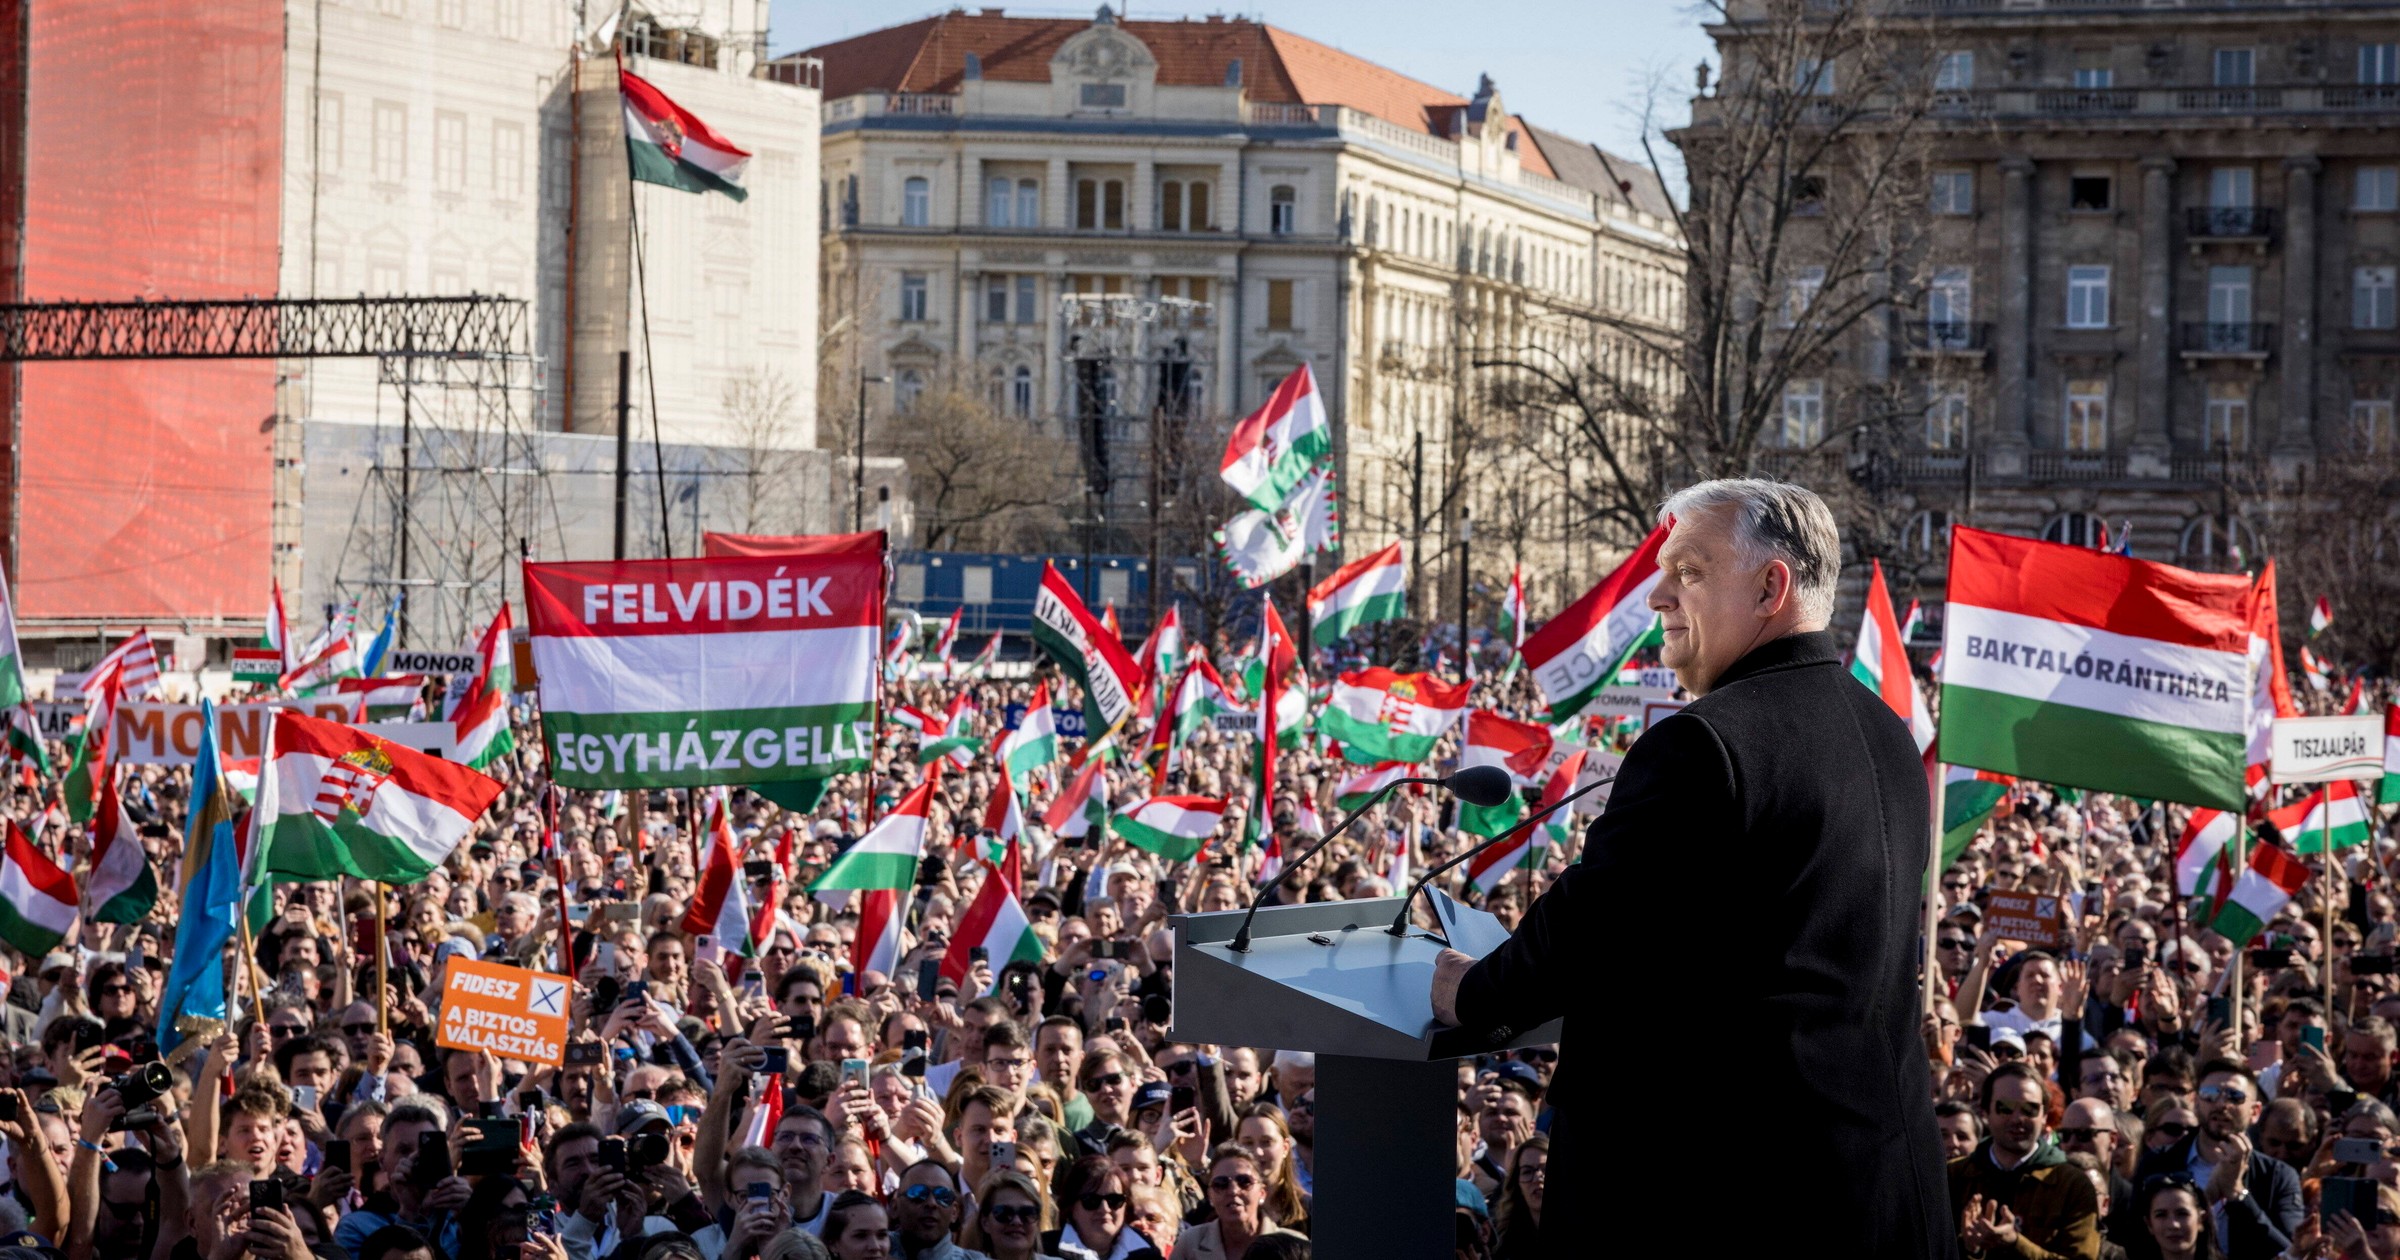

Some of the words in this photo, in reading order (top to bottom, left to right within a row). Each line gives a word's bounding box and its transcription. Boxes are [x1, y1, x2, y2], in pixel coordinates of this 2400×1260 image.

[583, 565, 833, 625] FELVIDÉK
[393, 653, 475, 673] MONOR
[1966, 635, 2230, 703] BAKTALÓRÁNTHÁZA
[556, 718, 876, 774] EGYHÁZGELLE
[2292, 731, 2366, 759] TISZAALPÁR
[450, 971, 521, 1001] FIDESZ
[445, 1005, 463, 1024] A
[465, 1008, 538, 1037] BIZTOS
[445, 1023, 560, 1061] VÁLASZTÁS
